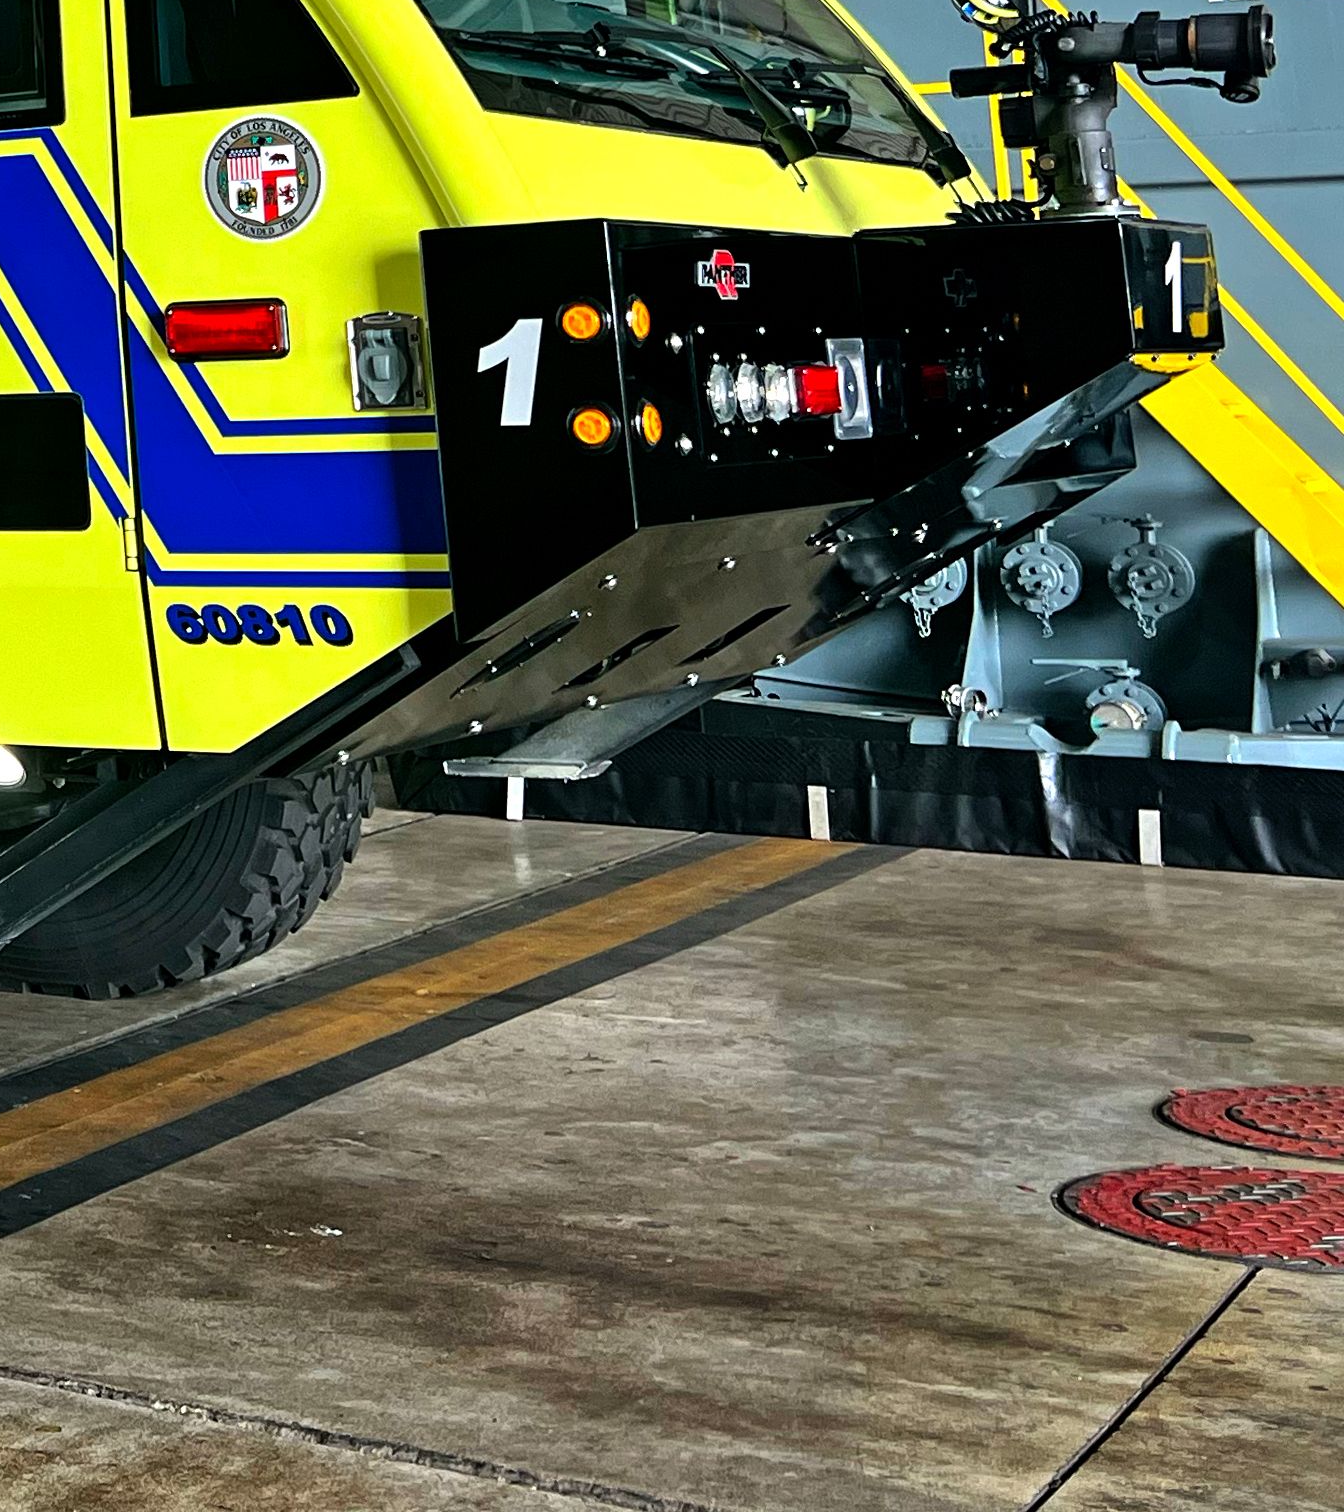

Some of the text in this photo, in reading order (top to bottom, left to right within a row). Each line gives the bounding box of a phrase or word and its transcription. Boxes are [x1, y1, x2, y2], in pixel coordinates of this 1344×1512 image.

[213, 121, 311, 161] CITY OF LOS ANGELES
[230, 218, 276, 237] FOUNDED
[1164, 241, 1183, 334] 1
[477, 317, 544, 428] 1
[165, 603, 354, 647] 60810
